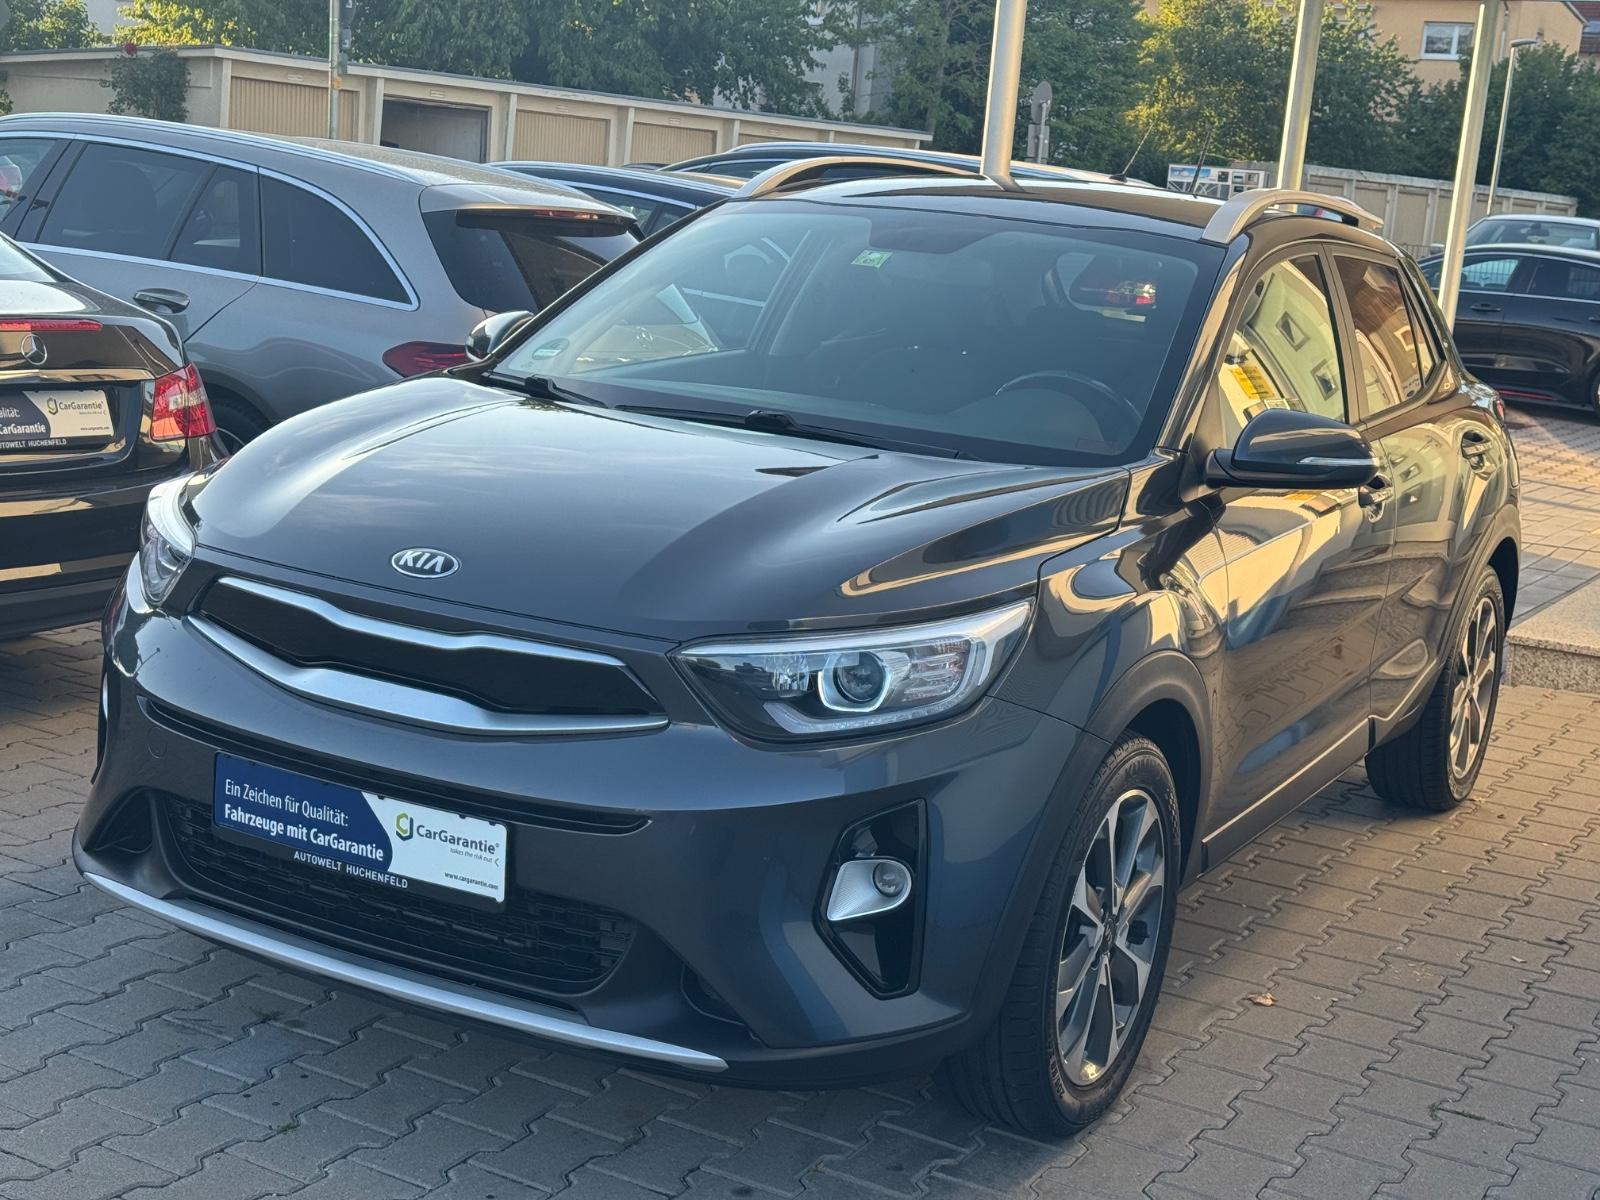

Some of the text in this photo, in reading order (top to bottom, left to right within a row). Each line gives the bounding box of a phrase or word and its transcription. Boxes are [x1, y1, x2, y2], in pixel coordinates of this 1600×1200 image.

[398, 550, 445, 573] KIA
[225, 778, 348, 827] Ein Zeichen für Qualität:
[225, 804, 383, 861] Fahrzeuge mit CarGarantie
[293, 851, 408, 888] AUTOWELT HUCHENFELD
[464, 850, 473, 858] the
[474, 853, 483, 861] risk
[444, 871, 499, 890] www.cargarantie.com
